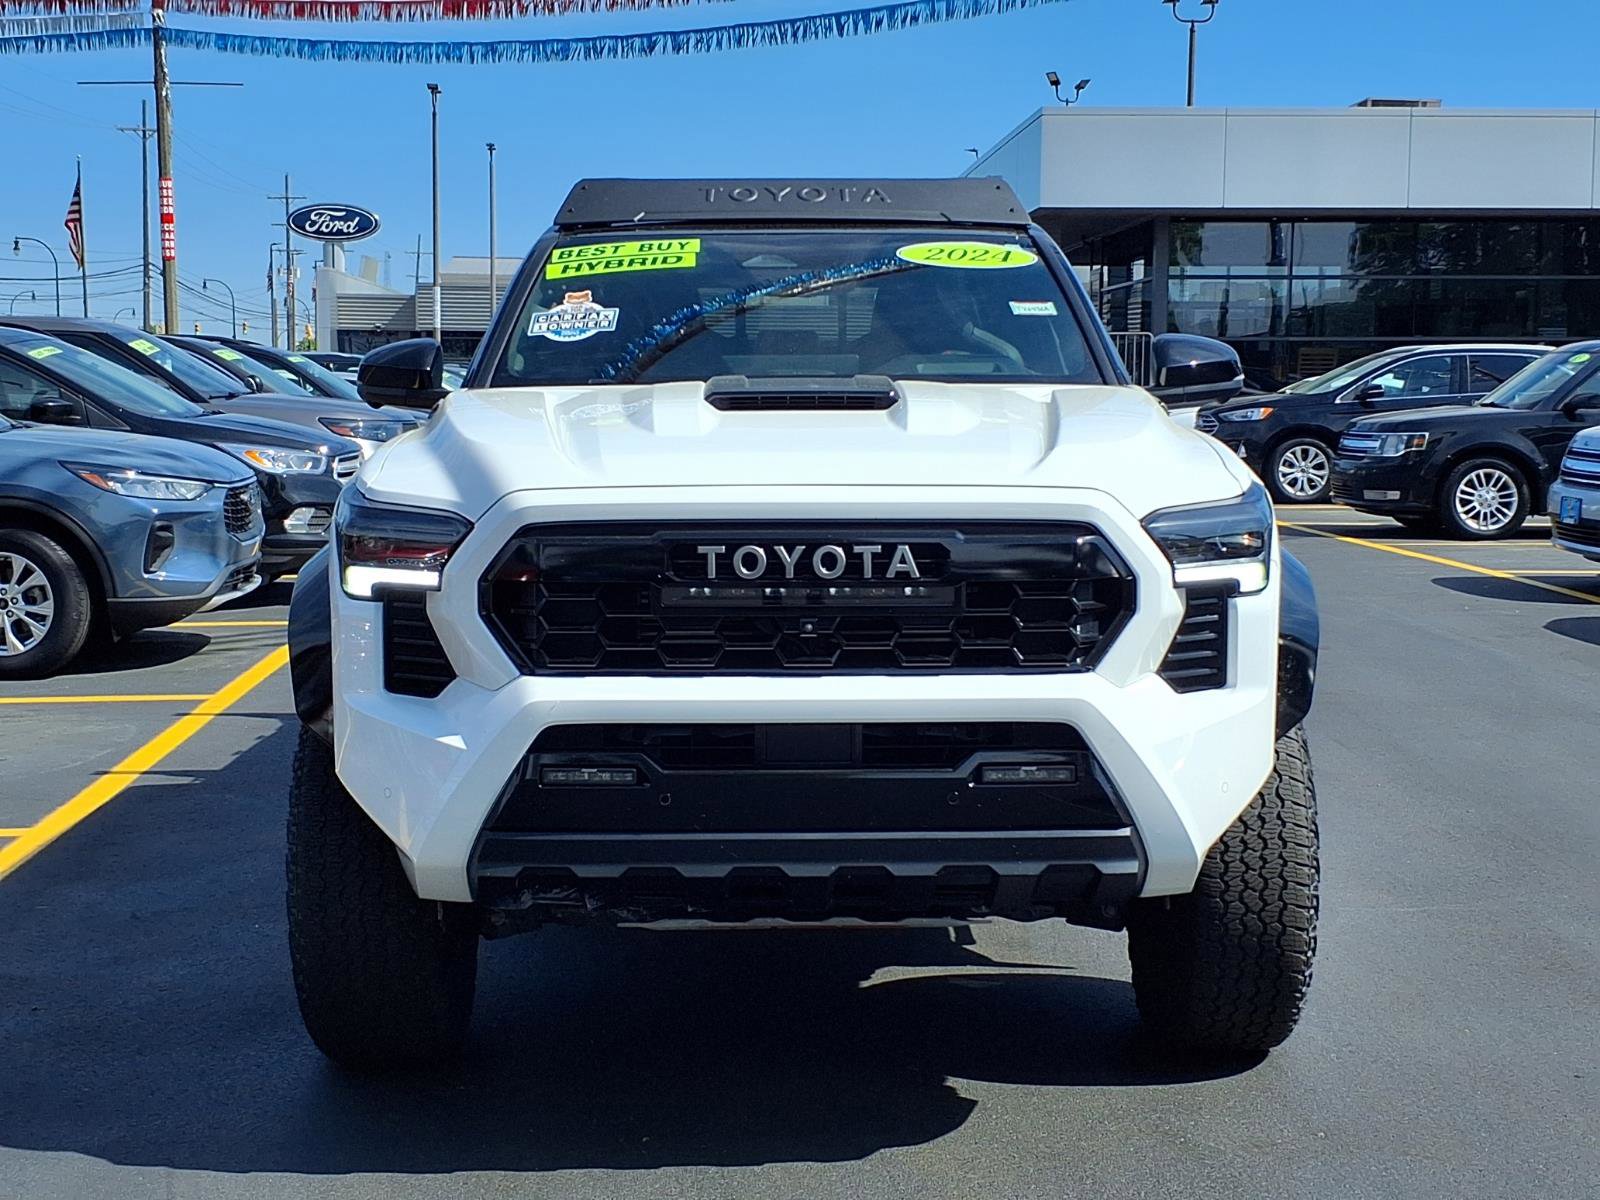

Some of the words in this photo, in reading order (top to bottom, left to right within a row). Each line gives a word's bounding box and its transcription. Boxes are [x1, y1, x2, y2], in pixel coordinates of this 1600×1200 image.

[699, 187, 892, 204] TOYOTA
[305, 209, 360, 233] Ford
[557, 244, 626, 260] BEST
[638, 241, 690, 253] BUY
[924, 247, 1014, 264] 2024
[560, 255, 684, 274] HYBRID
[537, 312, 611, 322] CARFAX
[548, 320, 610, 331] OWNER
[697, 544, 921, 580] TOYOTA
